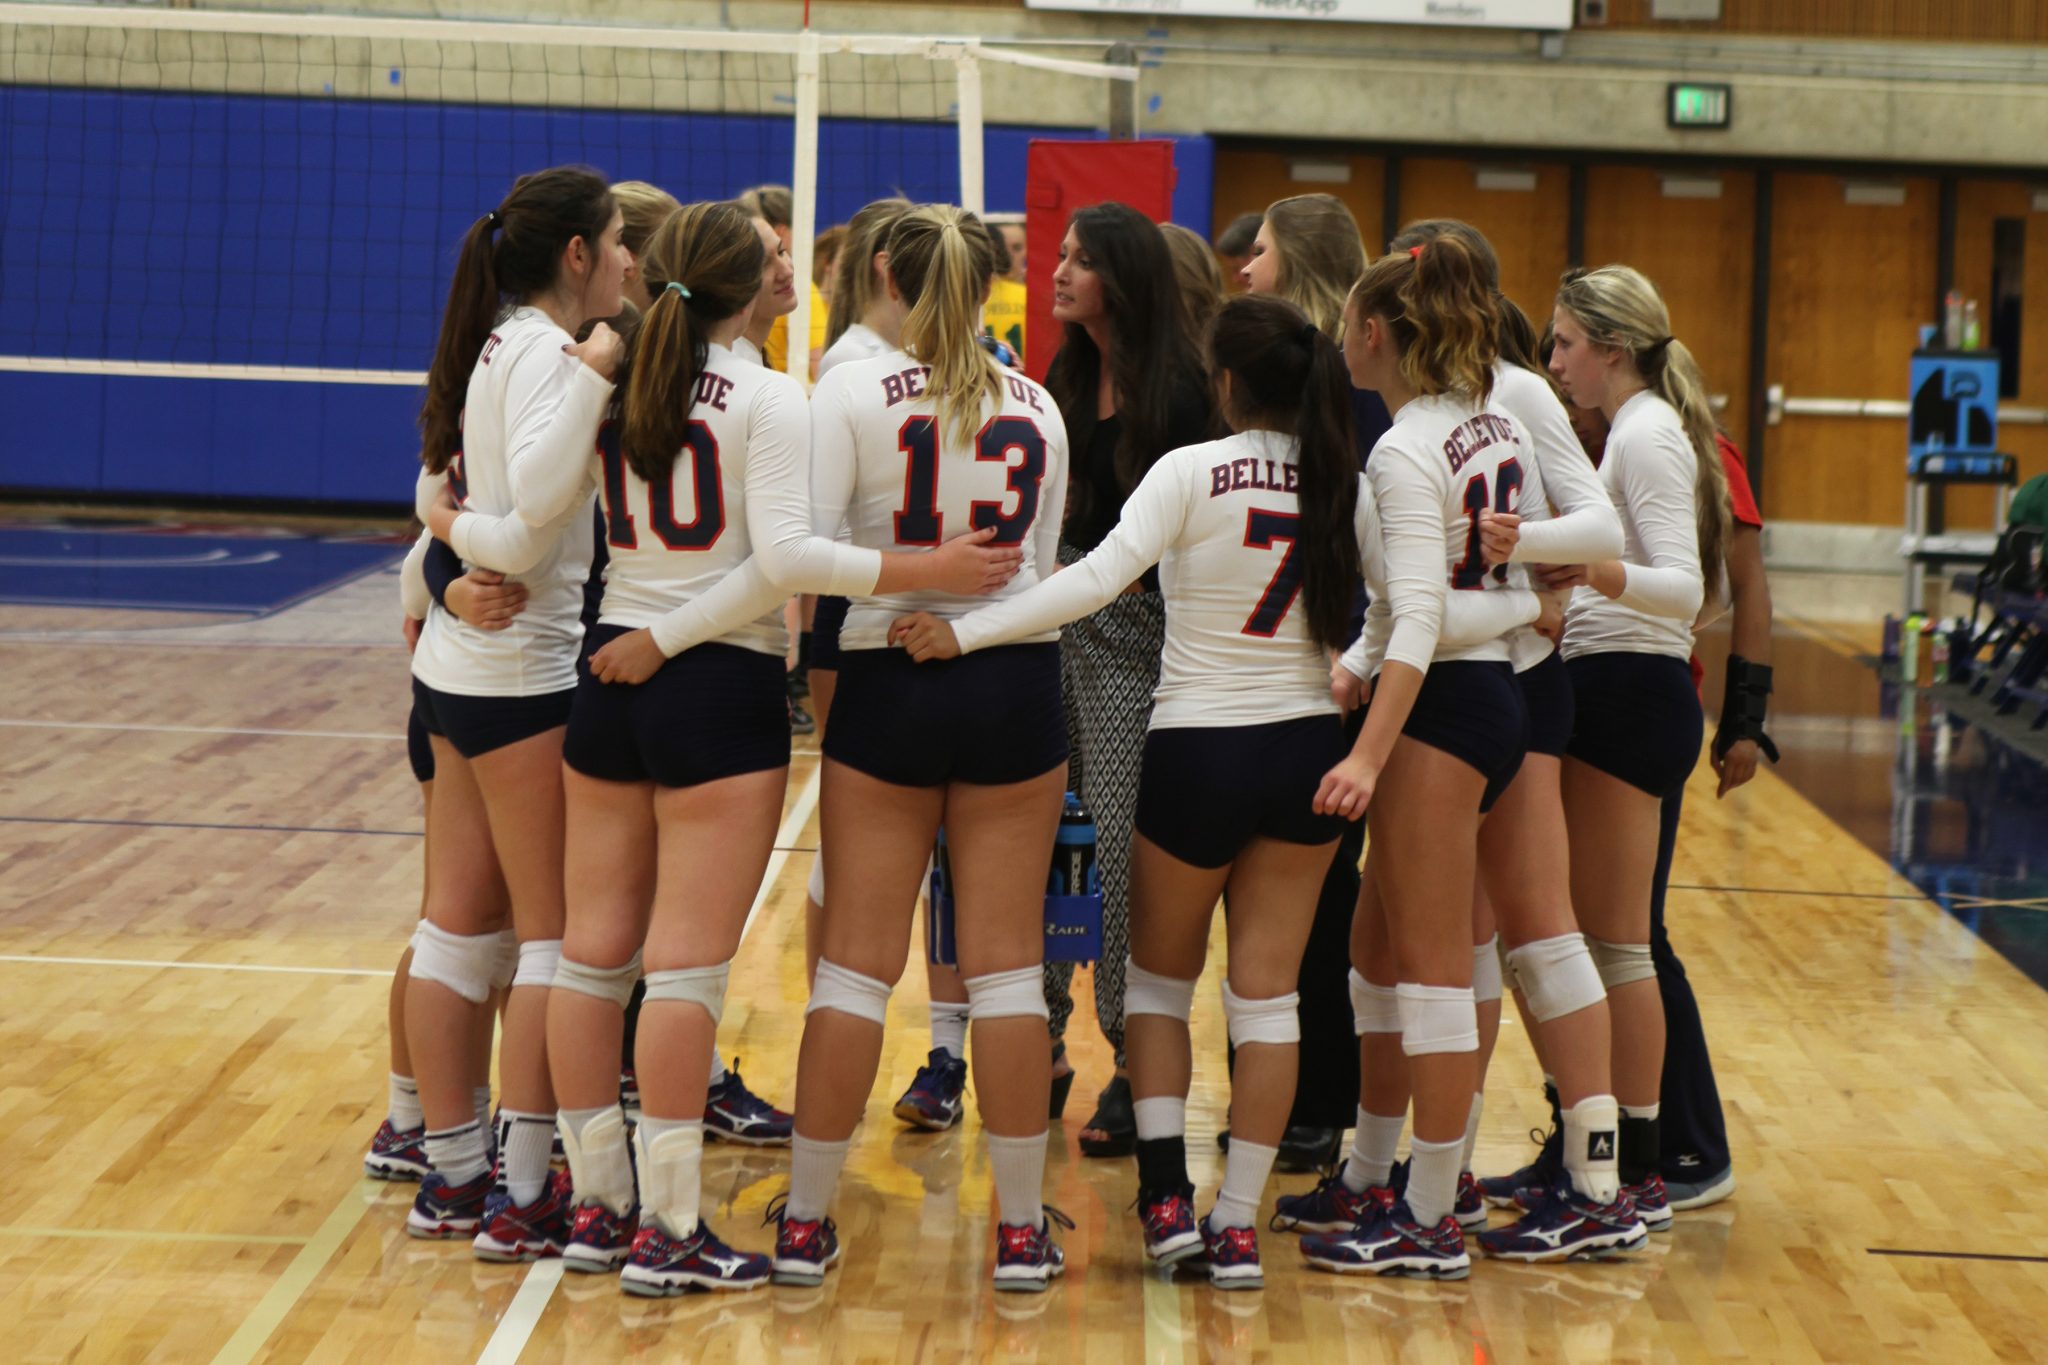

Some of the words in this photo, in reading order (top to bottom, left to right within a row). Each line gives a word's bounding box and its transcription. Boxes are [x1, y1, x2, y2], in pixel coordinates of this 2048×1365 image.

[596, 419, 726, 551] 10
[893, 415, 1047, 547] 13
[1240, 506, 1305, 638] 7
